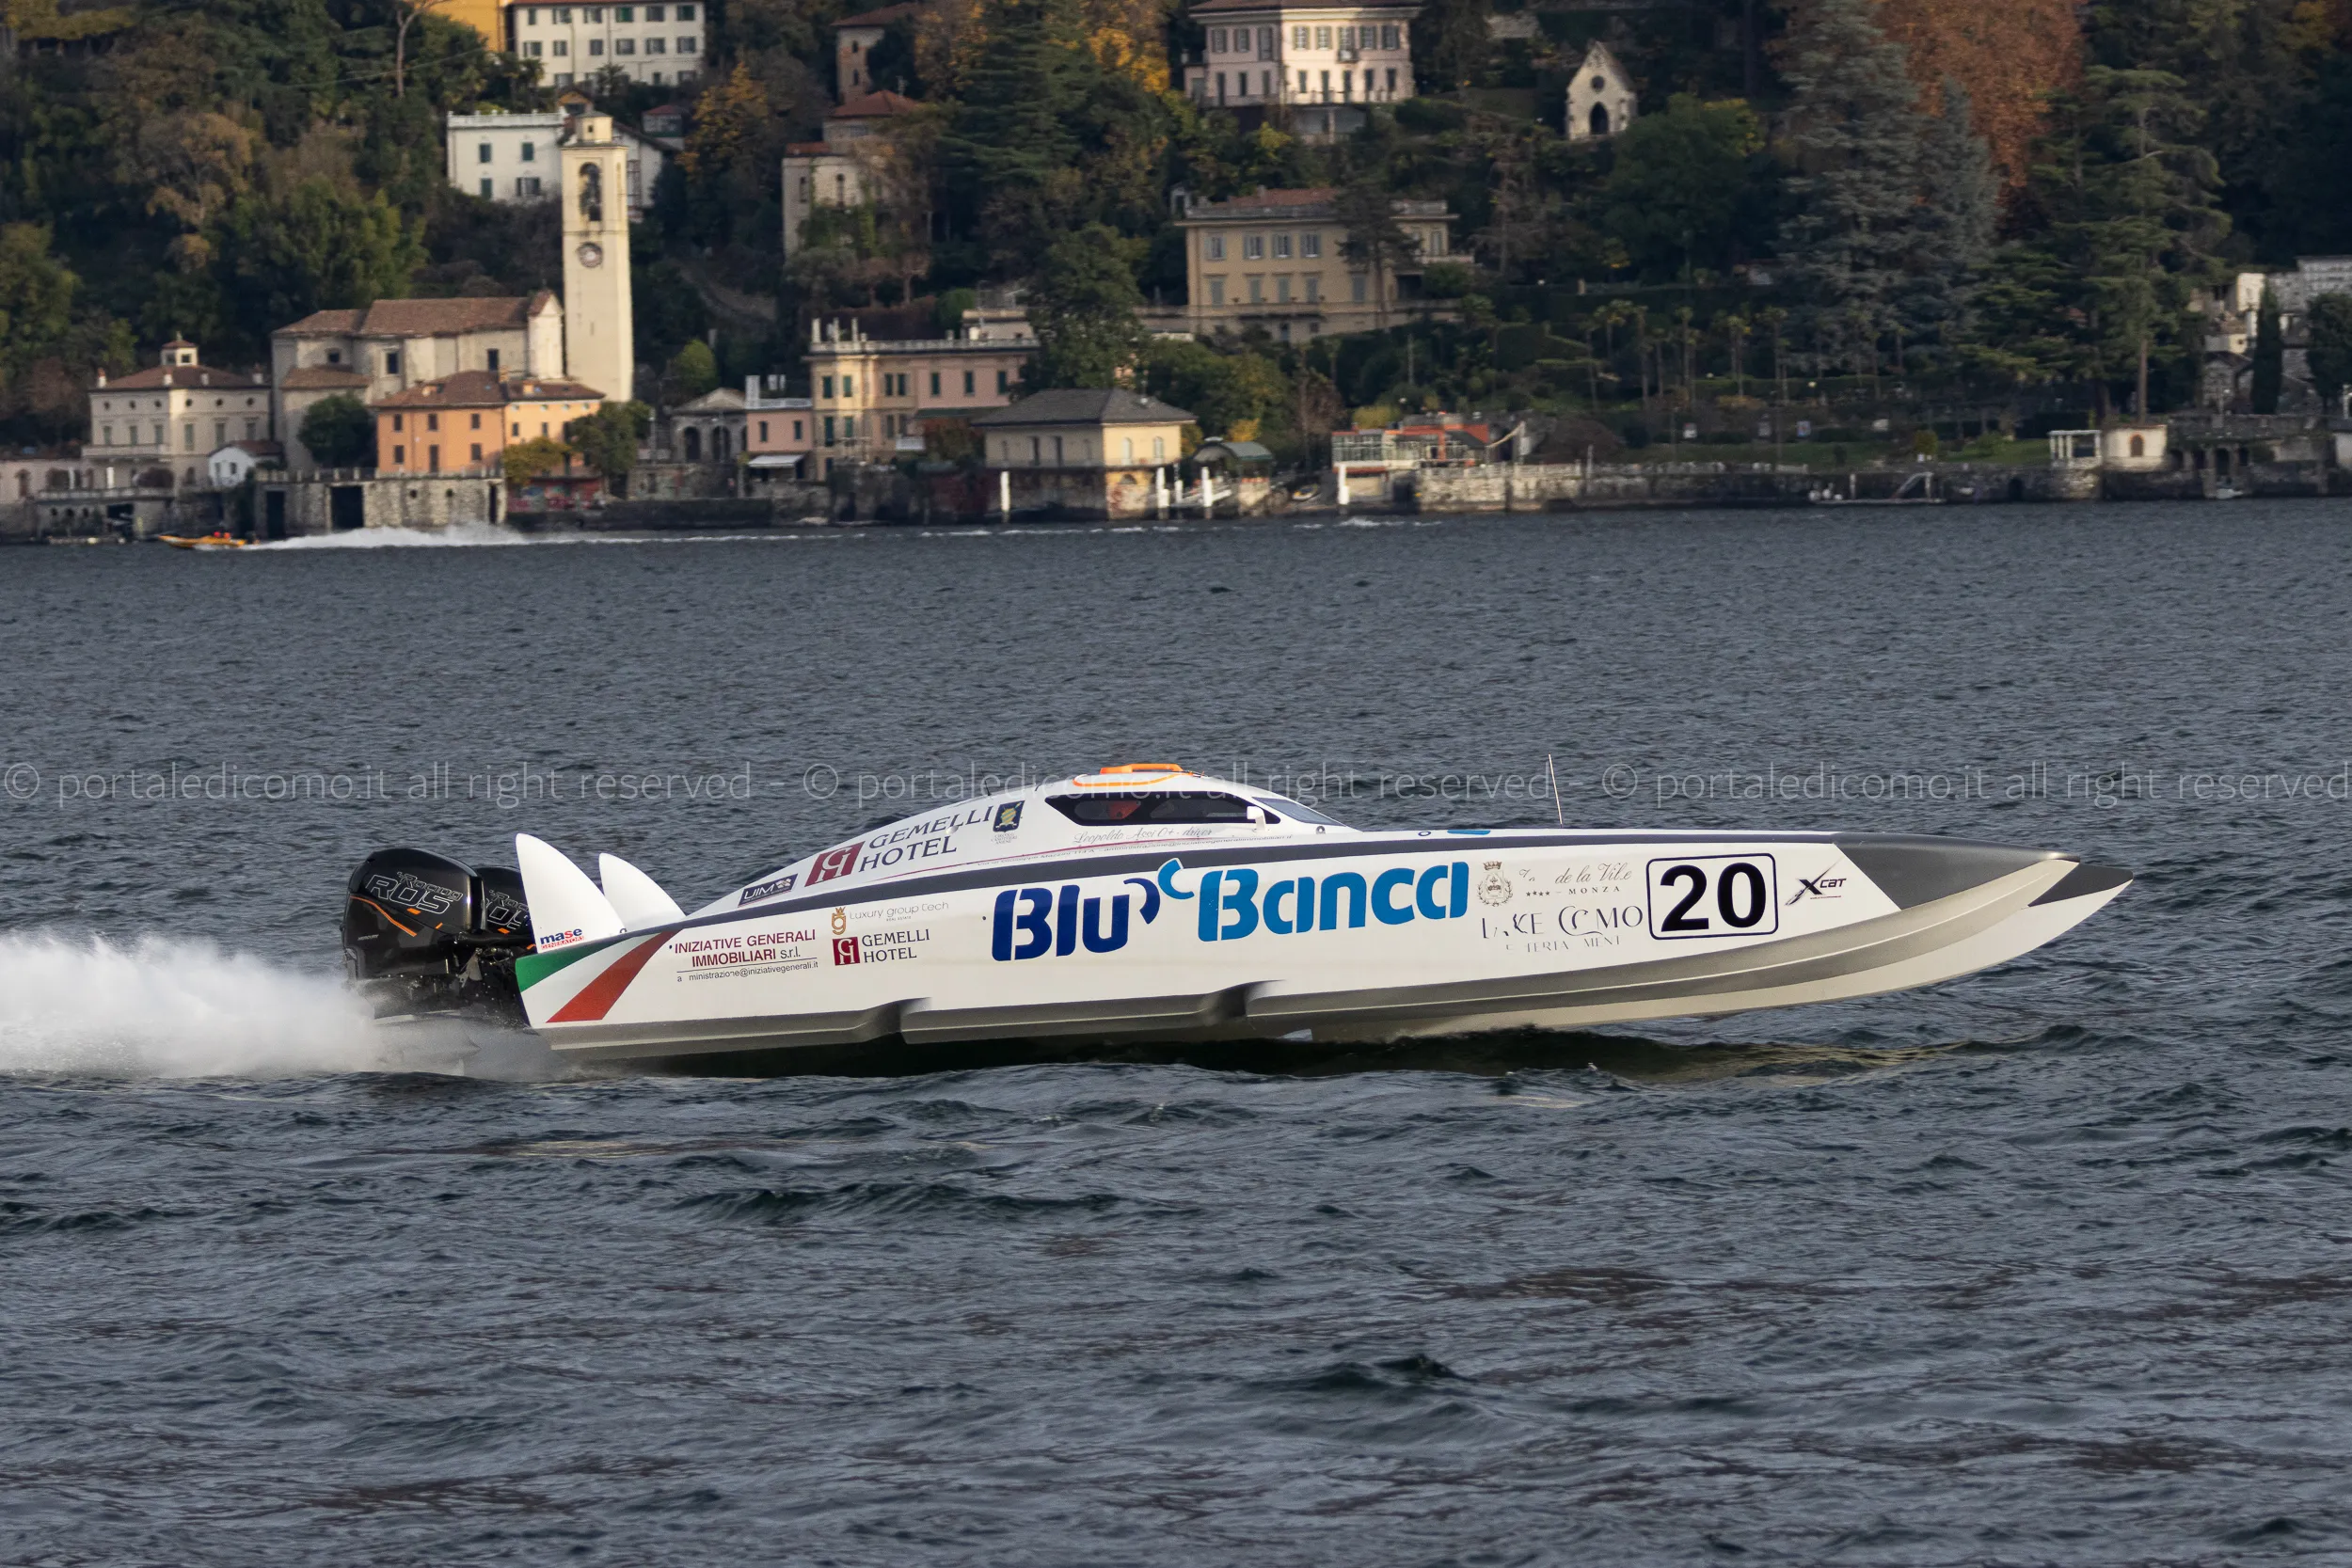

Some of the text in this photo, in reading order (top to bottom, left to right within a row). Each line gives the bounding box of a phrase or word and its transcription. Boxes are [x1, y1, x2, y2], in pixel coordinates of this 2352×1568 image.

[868, 805, 994, 849] GEMELLI
[1073, 828, 1124, 845] Leopoldo
[1183, 826, 1213, 837] driver
[858, 835, 957, 873] HOTEL
[1555, 867, 1573, 884] de
[1576, 864, 1592, 883] la
[364, 874, 451, 914] ROS
[744, 883, 776, 899] UIM
[1568, 885, 1620, 895] MONZA
[1660, 862, 1767, 932] 20
[850, 909, 884, 920] Luxury
[886, 904, 919, 918] group
[992, 860, 1470, 962] Blu Banca
[540, 928, 582, 944] mase
[675, 929, 816, 954] INIZIATIVE GENERALI
[862, 928, 930, 947] GEMELLI
[691, 946, 801, 968] IMMOBILIARI s.r.l.
[864, 947, 917, 963] HOTEL
[676, 961, 818, 983] aministrazione@iniziativegenerali.it
